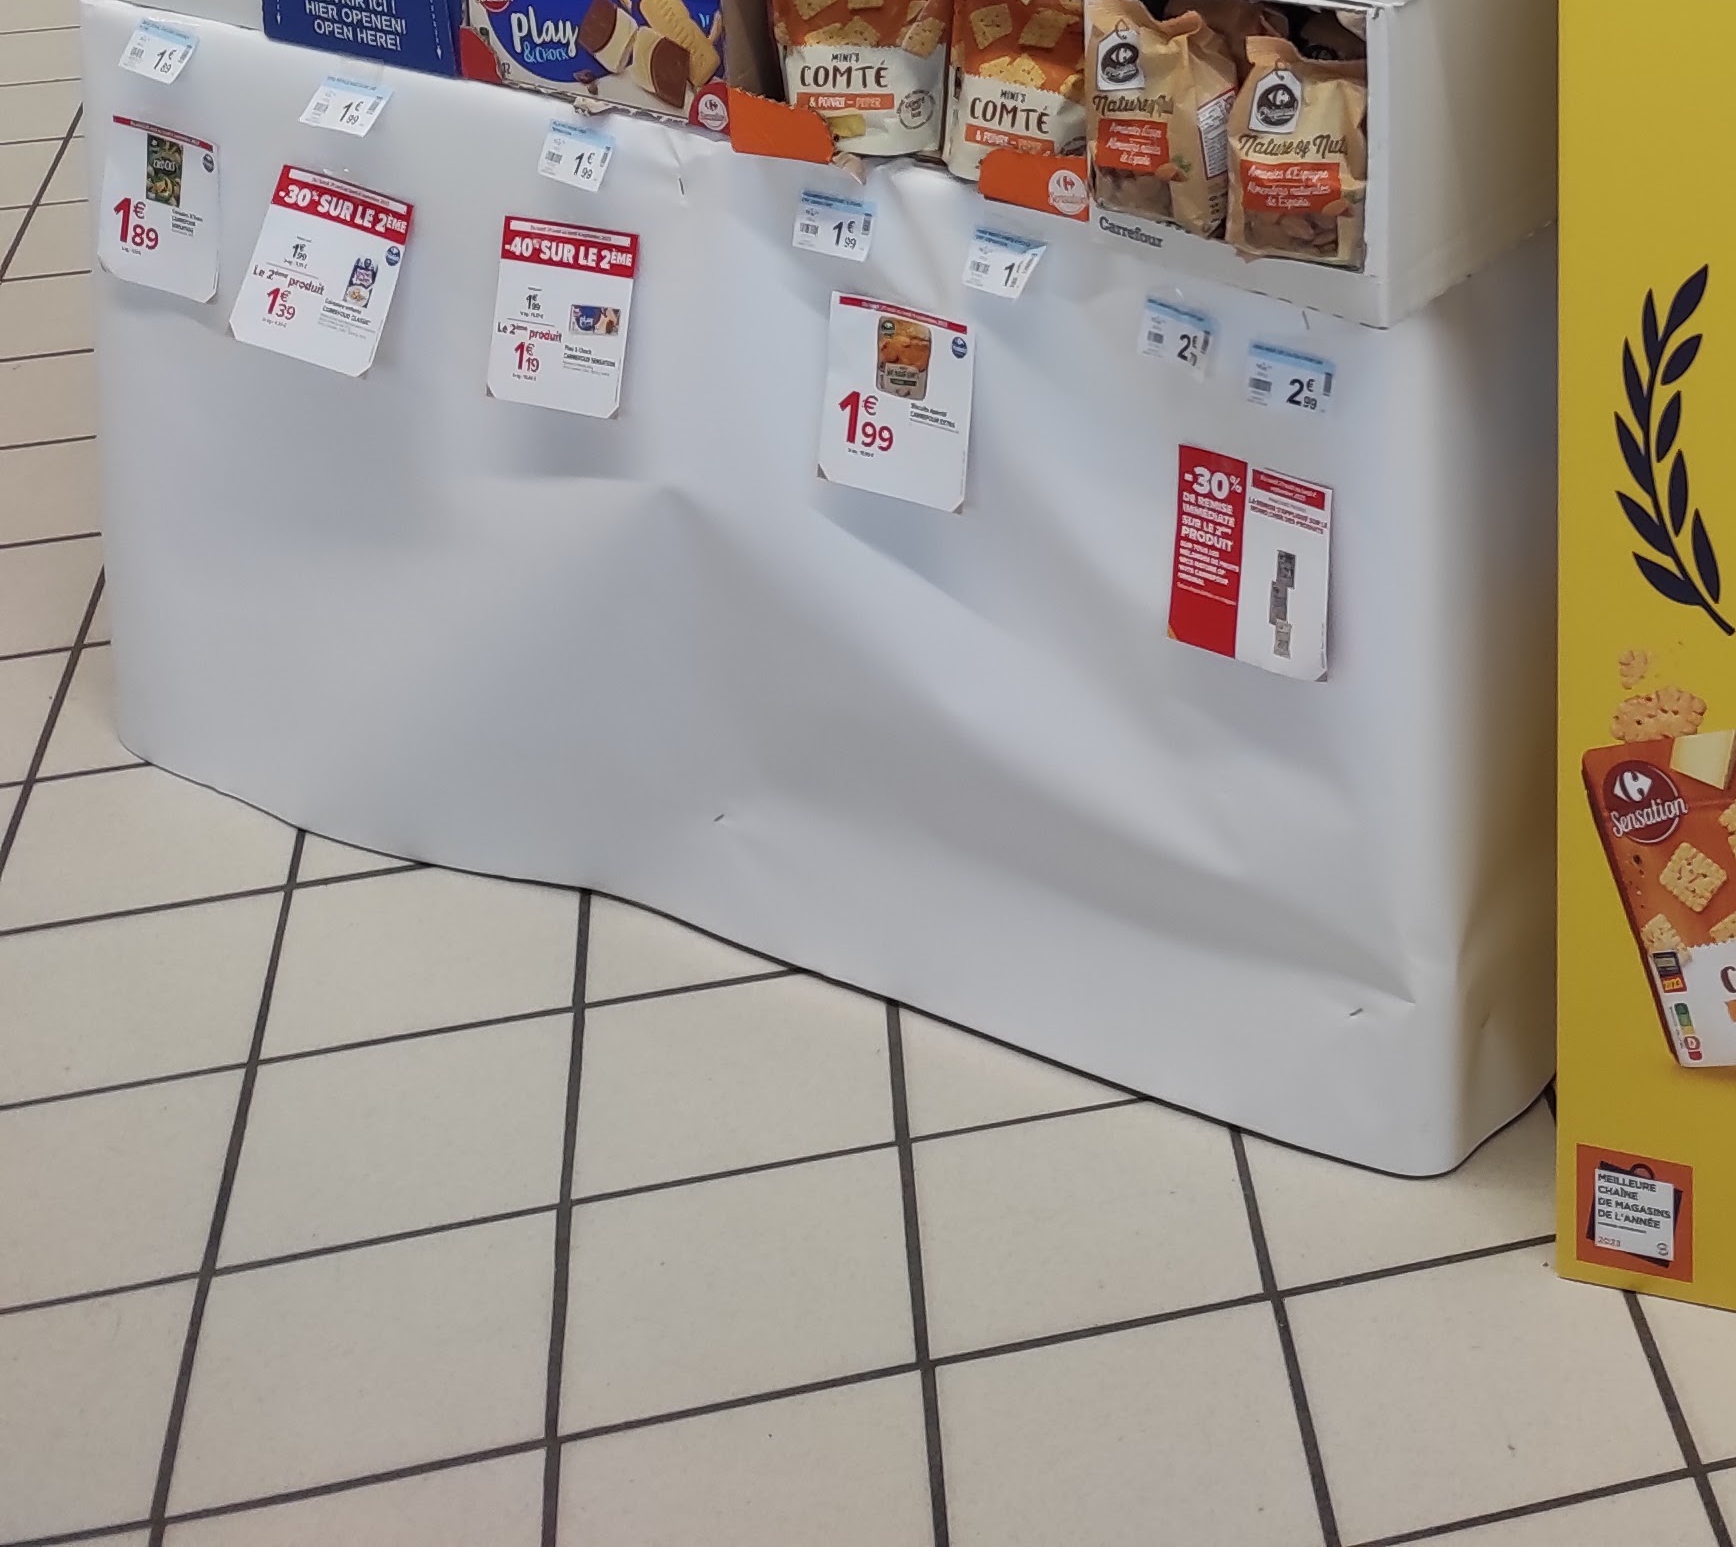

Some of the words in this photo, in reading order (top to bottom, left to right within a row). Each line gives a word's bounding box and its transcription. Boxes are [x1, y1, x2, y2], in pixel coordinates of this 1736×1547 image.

[317, 193, 352, 223] SUR
[353, 204, 375, 230] LE
[1098, 216, 1164, 249] Carrefour
[540, 242, 577, 266] SUR
[578, 250, 598, 268] LE
[252, 263, 266, 279] Le
[286, 275, 326, 297] produit
[528, 329, 563, 345] produit
[1181, 514, 1202, 530] SUR
[1179, 525, 1234, 553] PRODUIT
[1609, 795, 1689, 841] Sensation
[1597, 1172, 1657, 1194] MEILLEURE
[1597, 1196, 1613, 1208] DE
[1615, 1199, 1672, 1220] MAGASINS
[1597, 1208, 1613, 1220] DE
